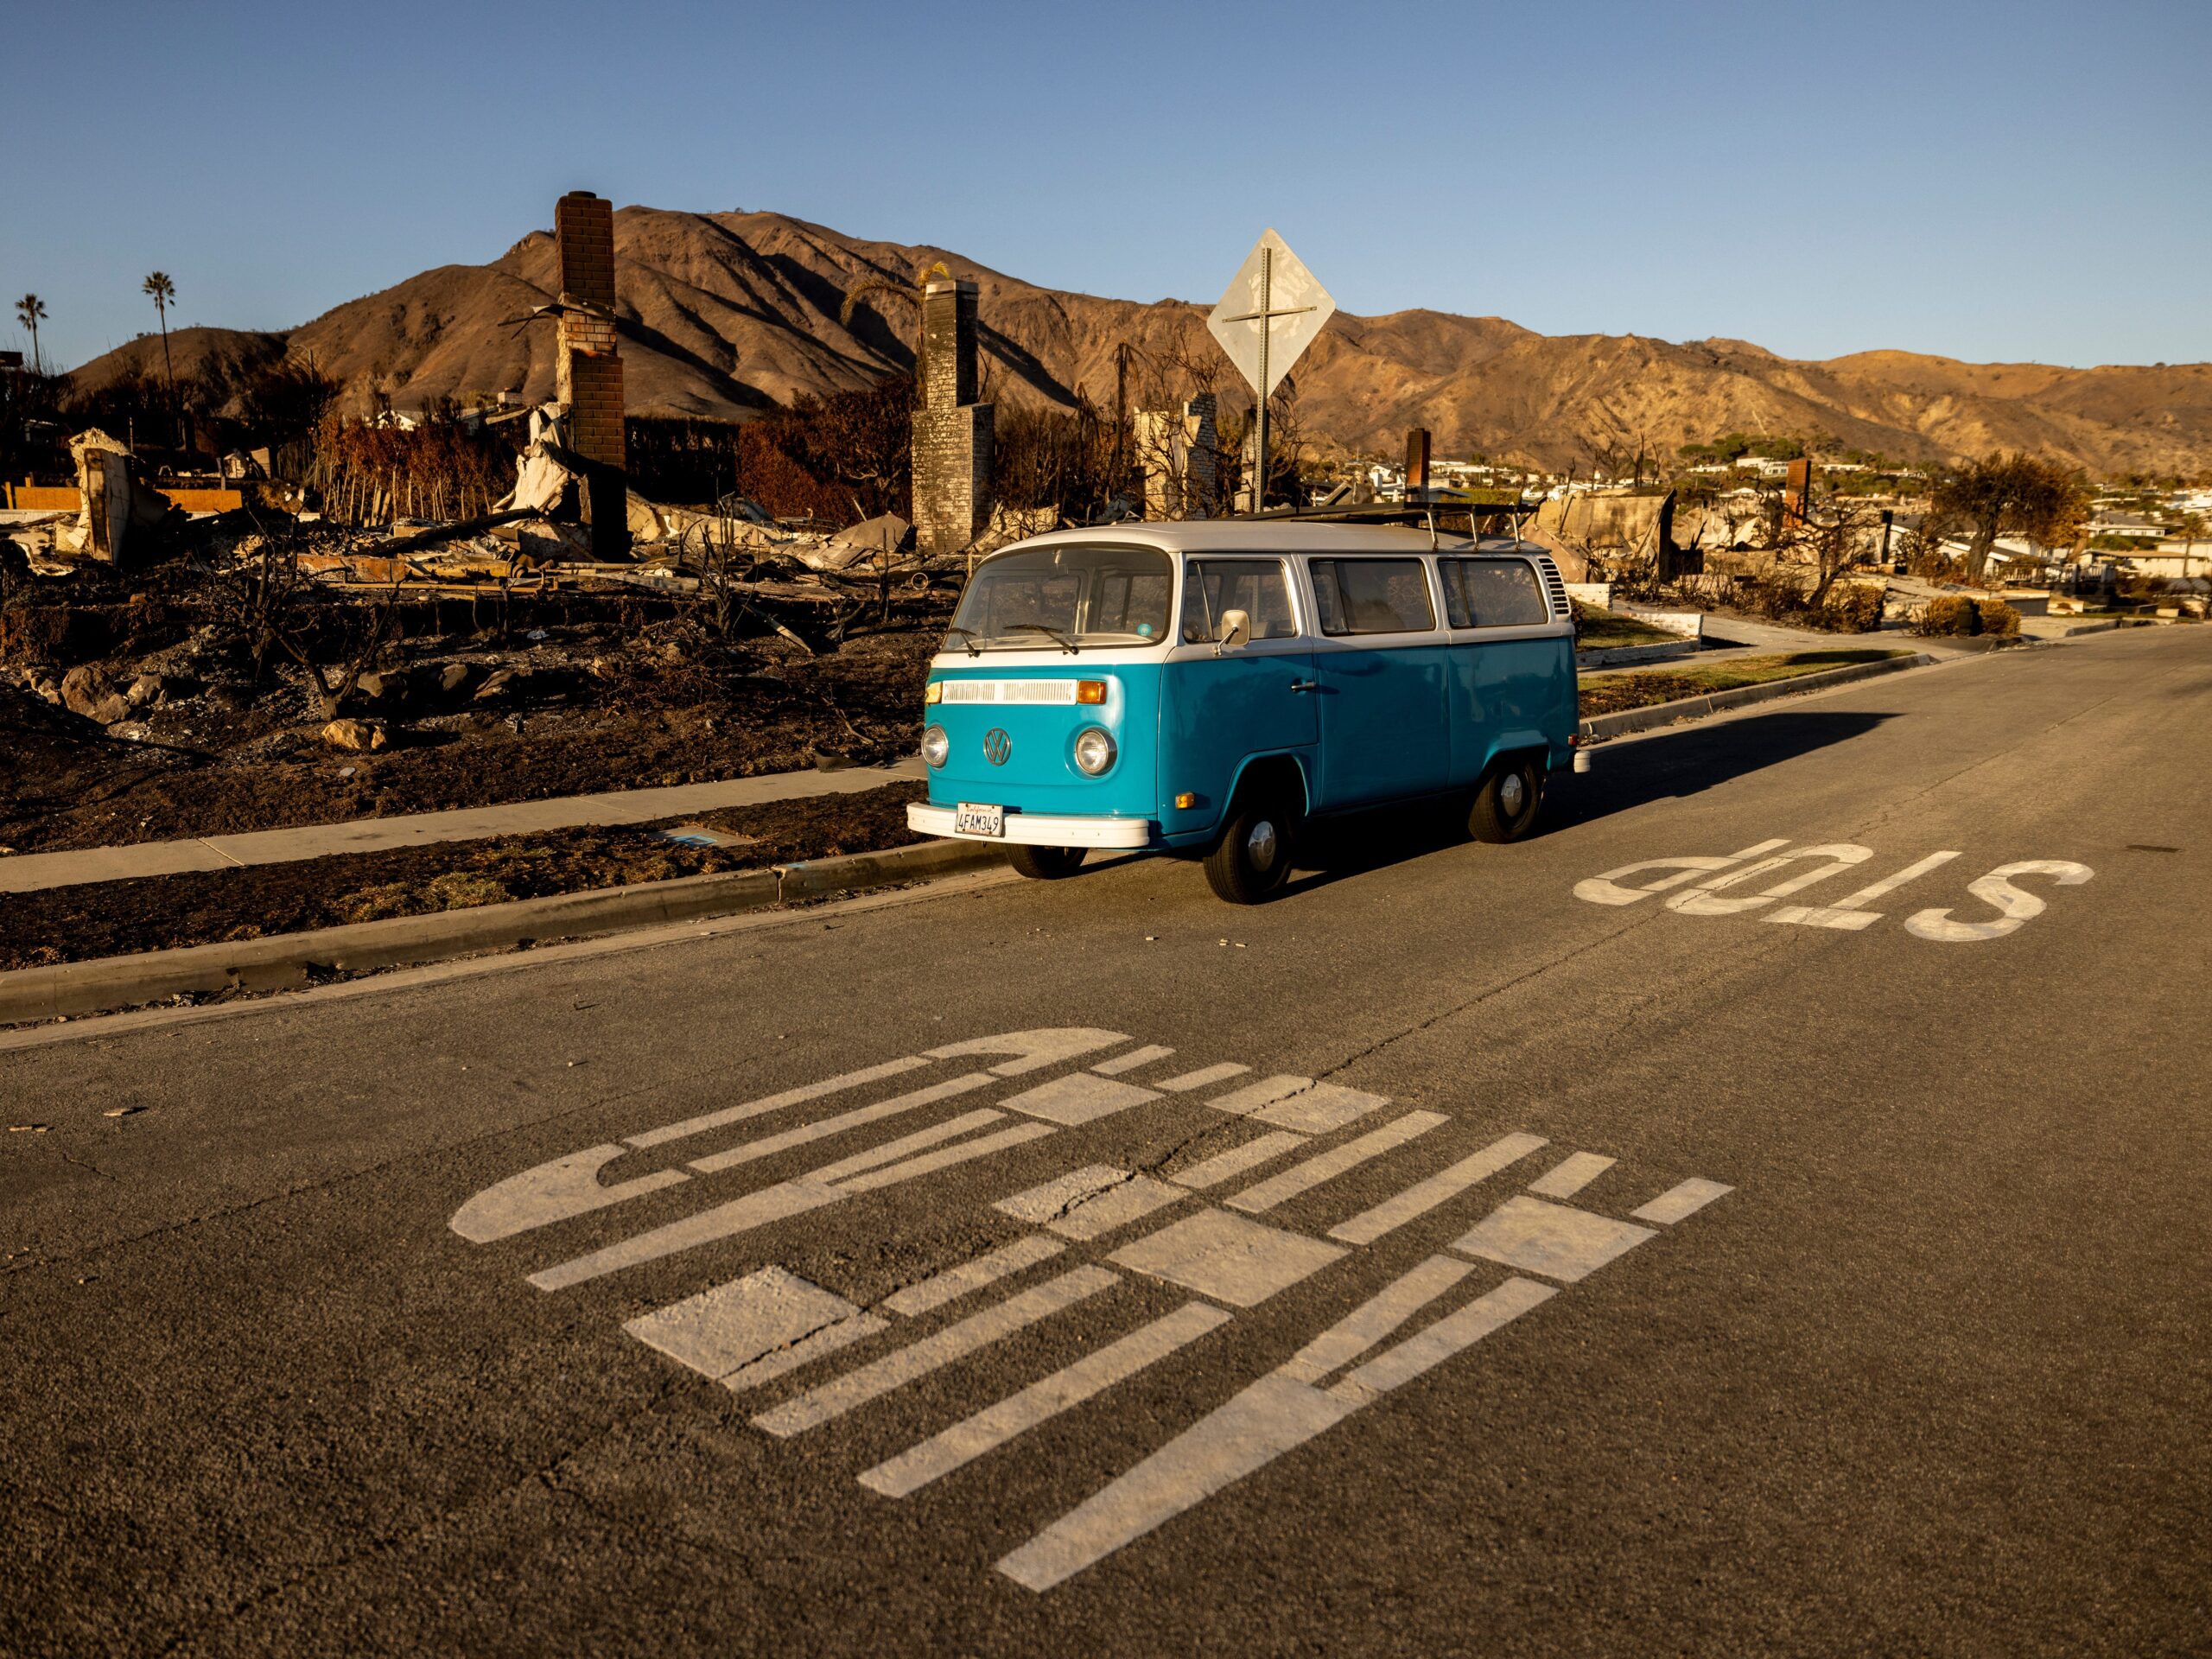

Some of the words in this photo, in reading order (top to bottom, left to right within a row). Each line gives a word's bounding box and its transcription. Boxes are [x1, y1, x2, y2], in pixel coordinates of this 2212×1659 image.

[983, 728, 1011, 766] VW
[958, 813, 999, 831] 4FAM349
[1573, 838, 2094, 942] STOP
[448, 1027, 1734, 1592] AHEAD
